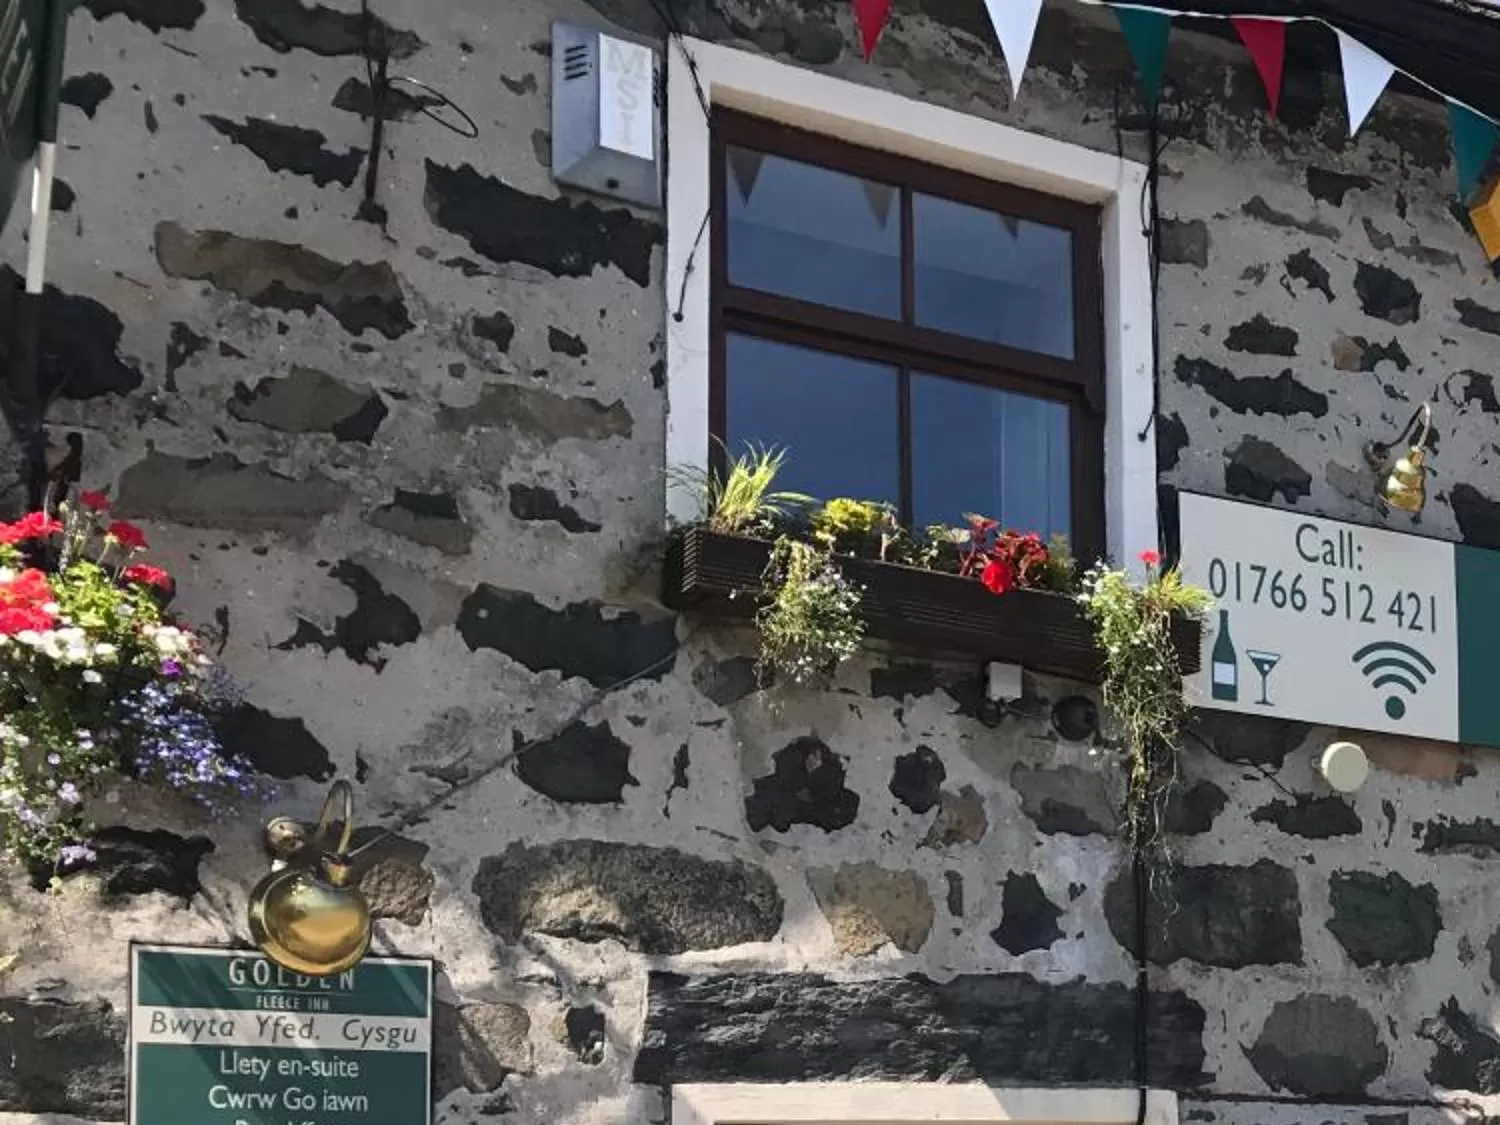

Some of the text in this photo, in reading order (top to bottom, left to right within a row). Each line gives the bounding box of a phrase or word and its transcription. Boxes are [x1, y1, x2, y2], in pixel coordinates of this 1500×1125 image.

[1295, 523, 1363, 571] Call:
[1209, 557, 1436, 633] 01766 512 421
[256, 994, 329, 1011] FLEECE INN
[150, 1010, 417, 1049] Bwyta Yfed. Cysgu
[220, 1050, 359, 1081] Llety en-suite
[209, 1085, 369, 1112] Cwrw Go iawn
